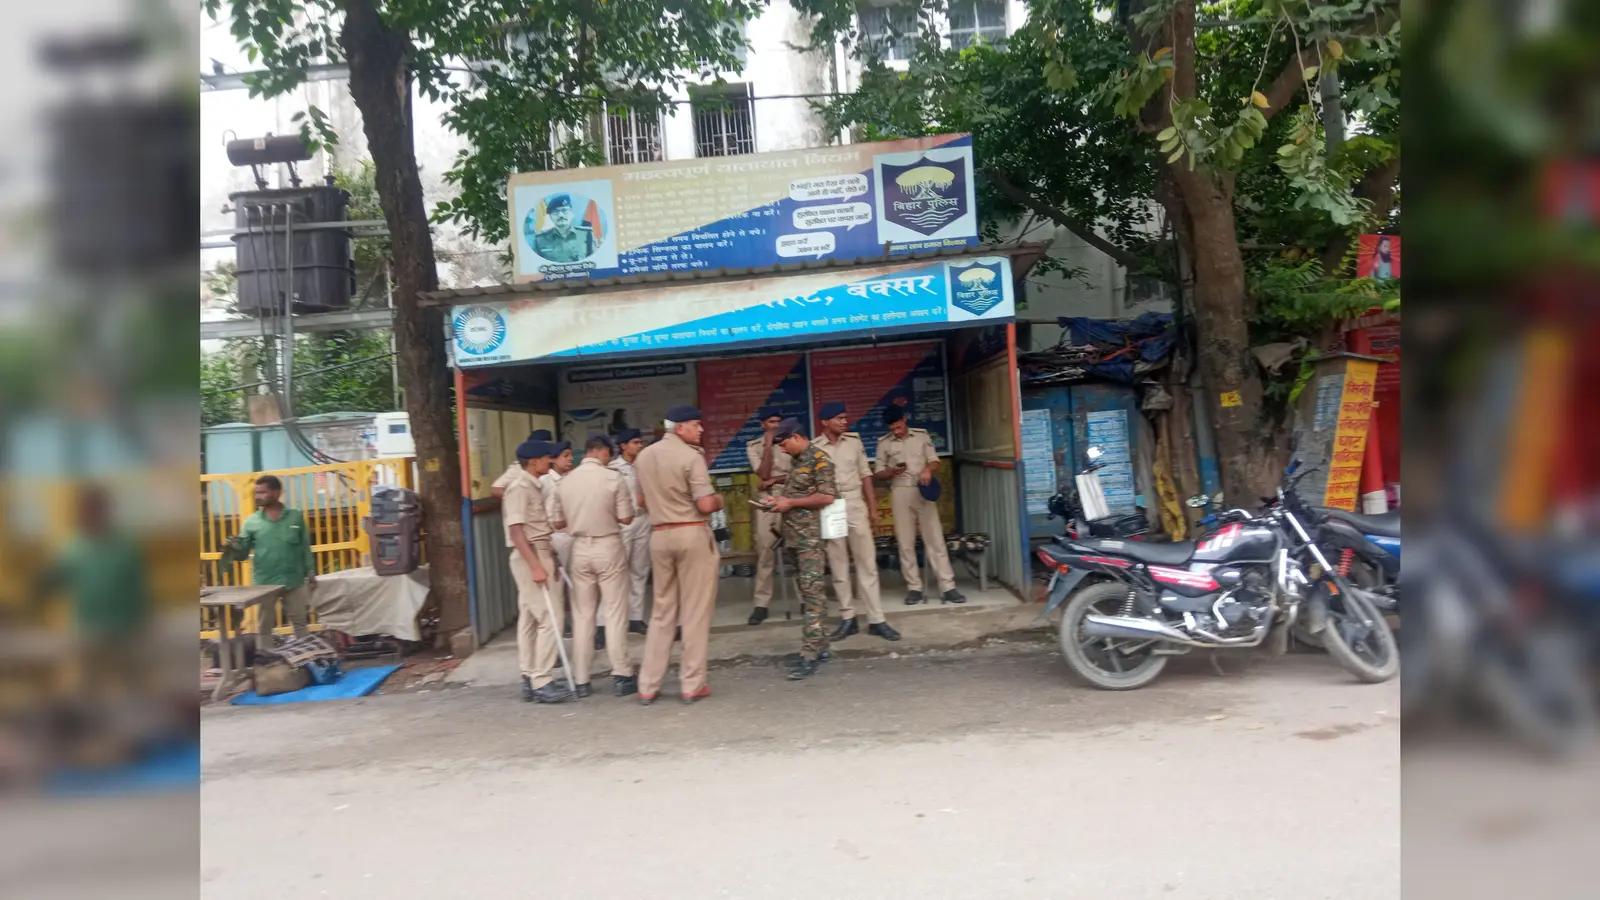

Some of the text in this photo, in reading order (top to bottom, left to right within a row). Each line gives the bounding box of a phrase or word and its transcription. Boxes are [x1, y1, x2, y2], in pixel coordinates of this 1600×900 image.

[622, 163, 710, 181] महत्वपूर्ण
[716, 157, 796, 174] यातायात
[804, 152, 861, 166] नियम
[892, 196, 958, 212] बिहार पुलिस
[846, 274, 938, 299] बक्सर
[957, 288, 998, 300] बिहार पुलिस
[850, 313, 868, 324] हेलमेट
[615, 366, 656, 378] Collection
